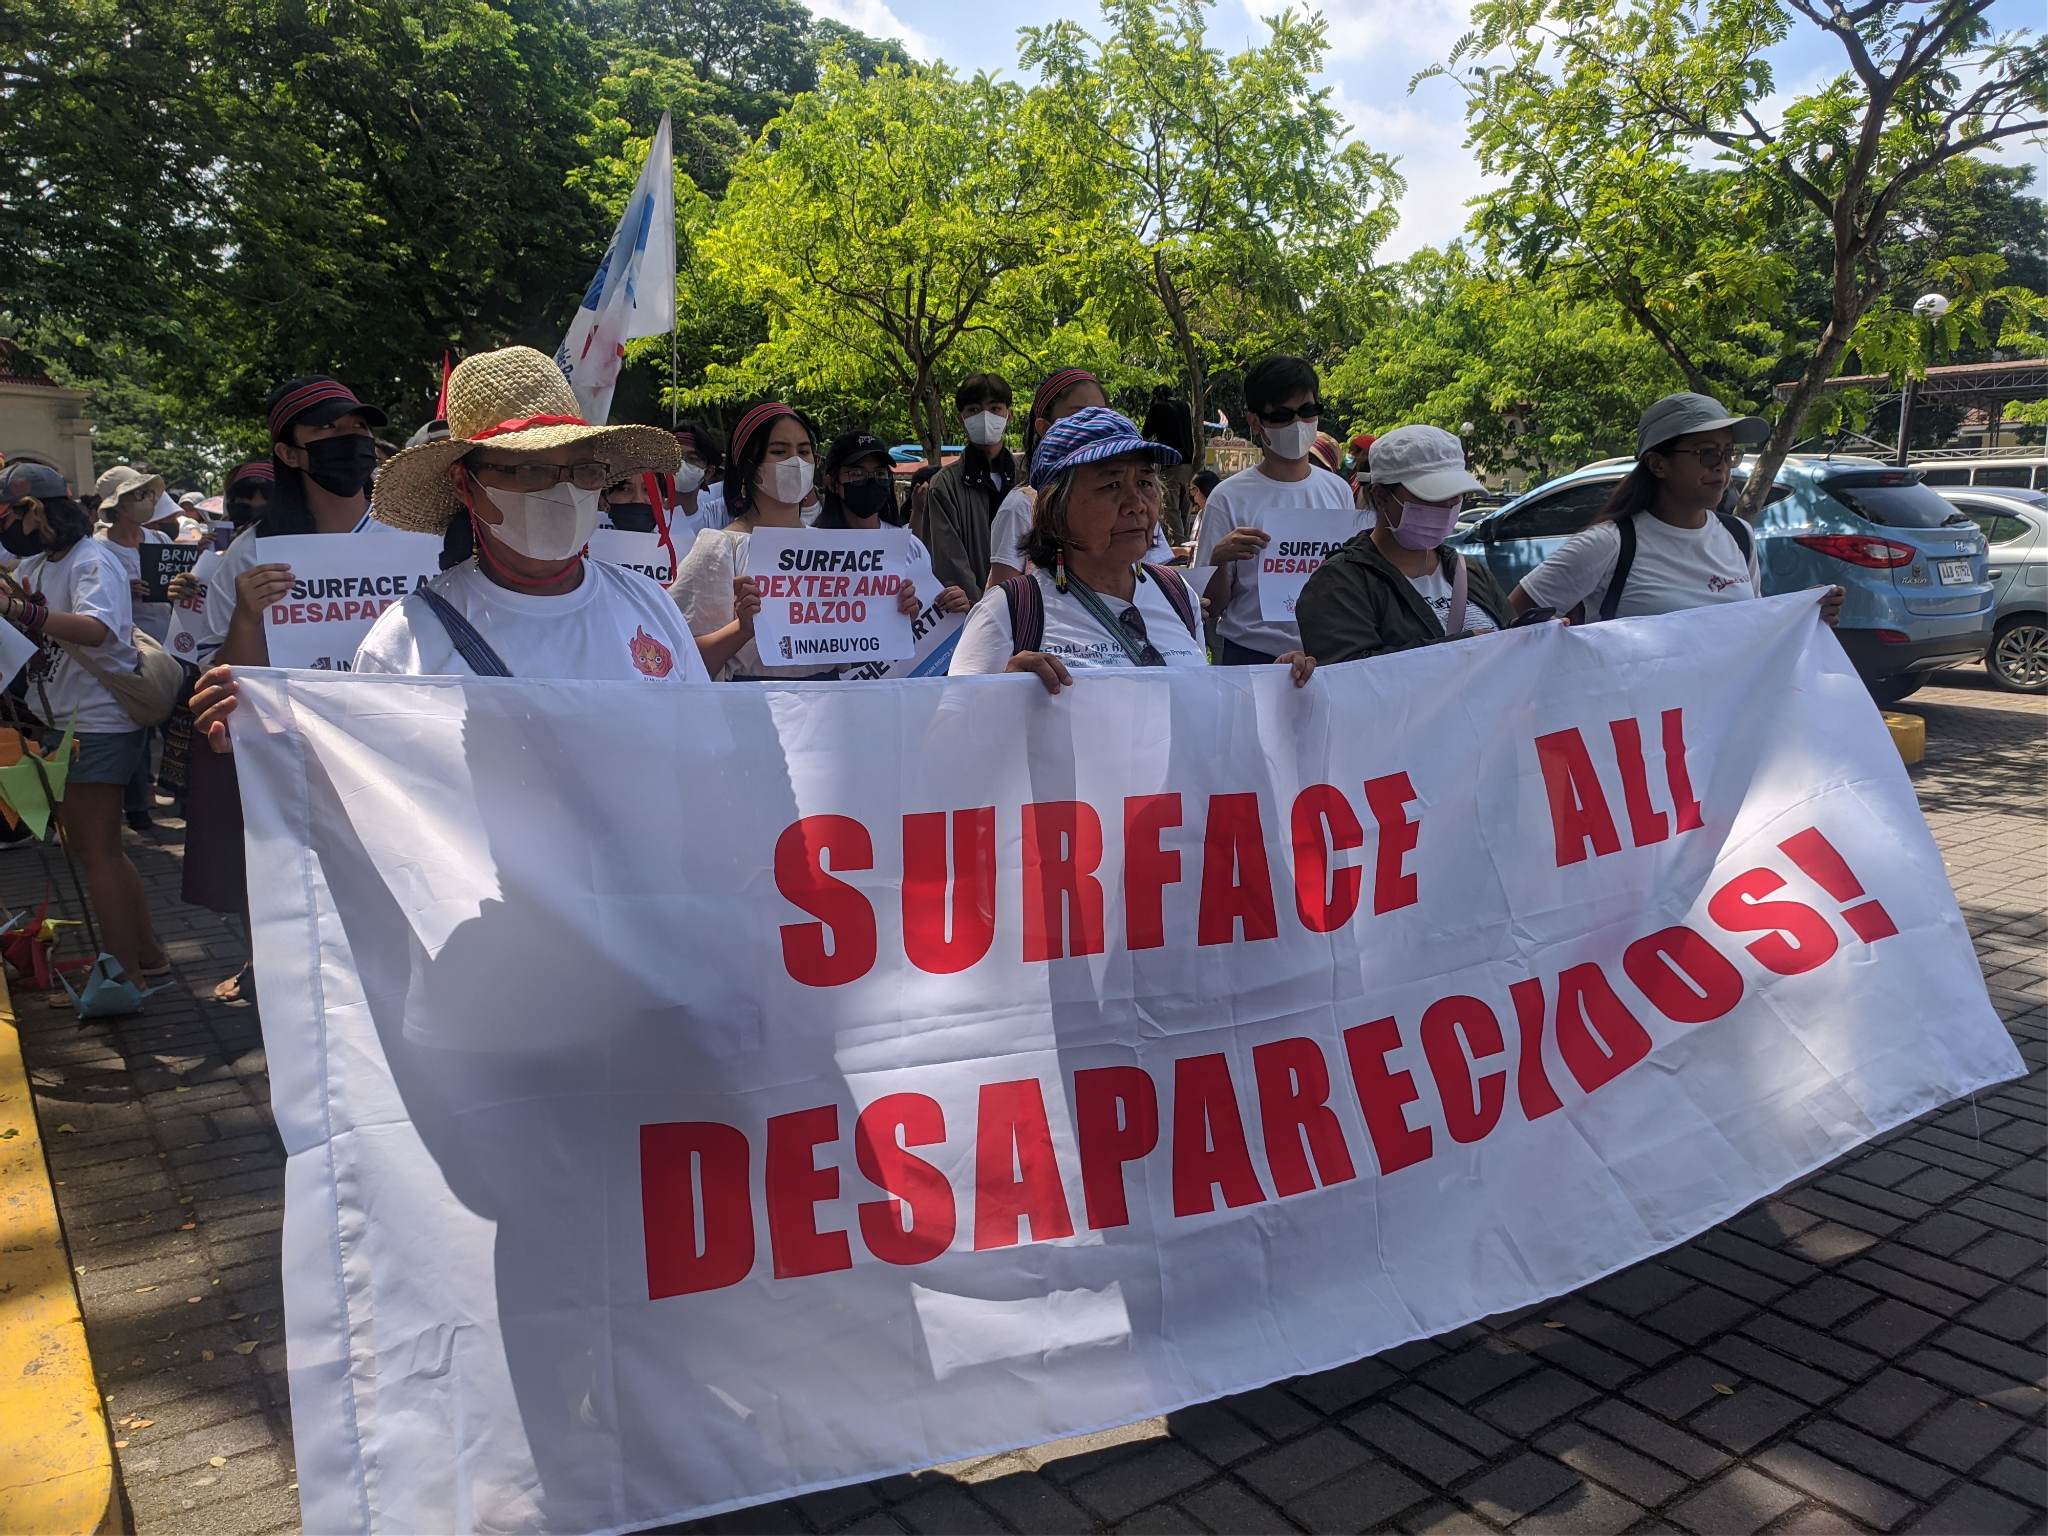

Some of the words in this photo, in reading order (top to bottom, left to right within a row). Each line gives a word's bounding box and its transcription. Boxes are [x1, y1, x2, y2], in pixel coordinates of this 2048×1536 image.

[158, 563, 191, 573] DEXT
[778, 549, 885, 572] SURFACE
[291, 576, 408, 599] SURFACE
[754, 575, 850, 598] DEXTER
[853, 575, 902, 598] AND
[789, 601, 867, 624] BAZOO
[794, 637, 880, 655] INNABUYOG
[775, 774, 1419, 987] SURFACE
[1535, 708, 1705, 867] ALL
[642, 828, 1895, 1299] DESAPARECIDOS!
